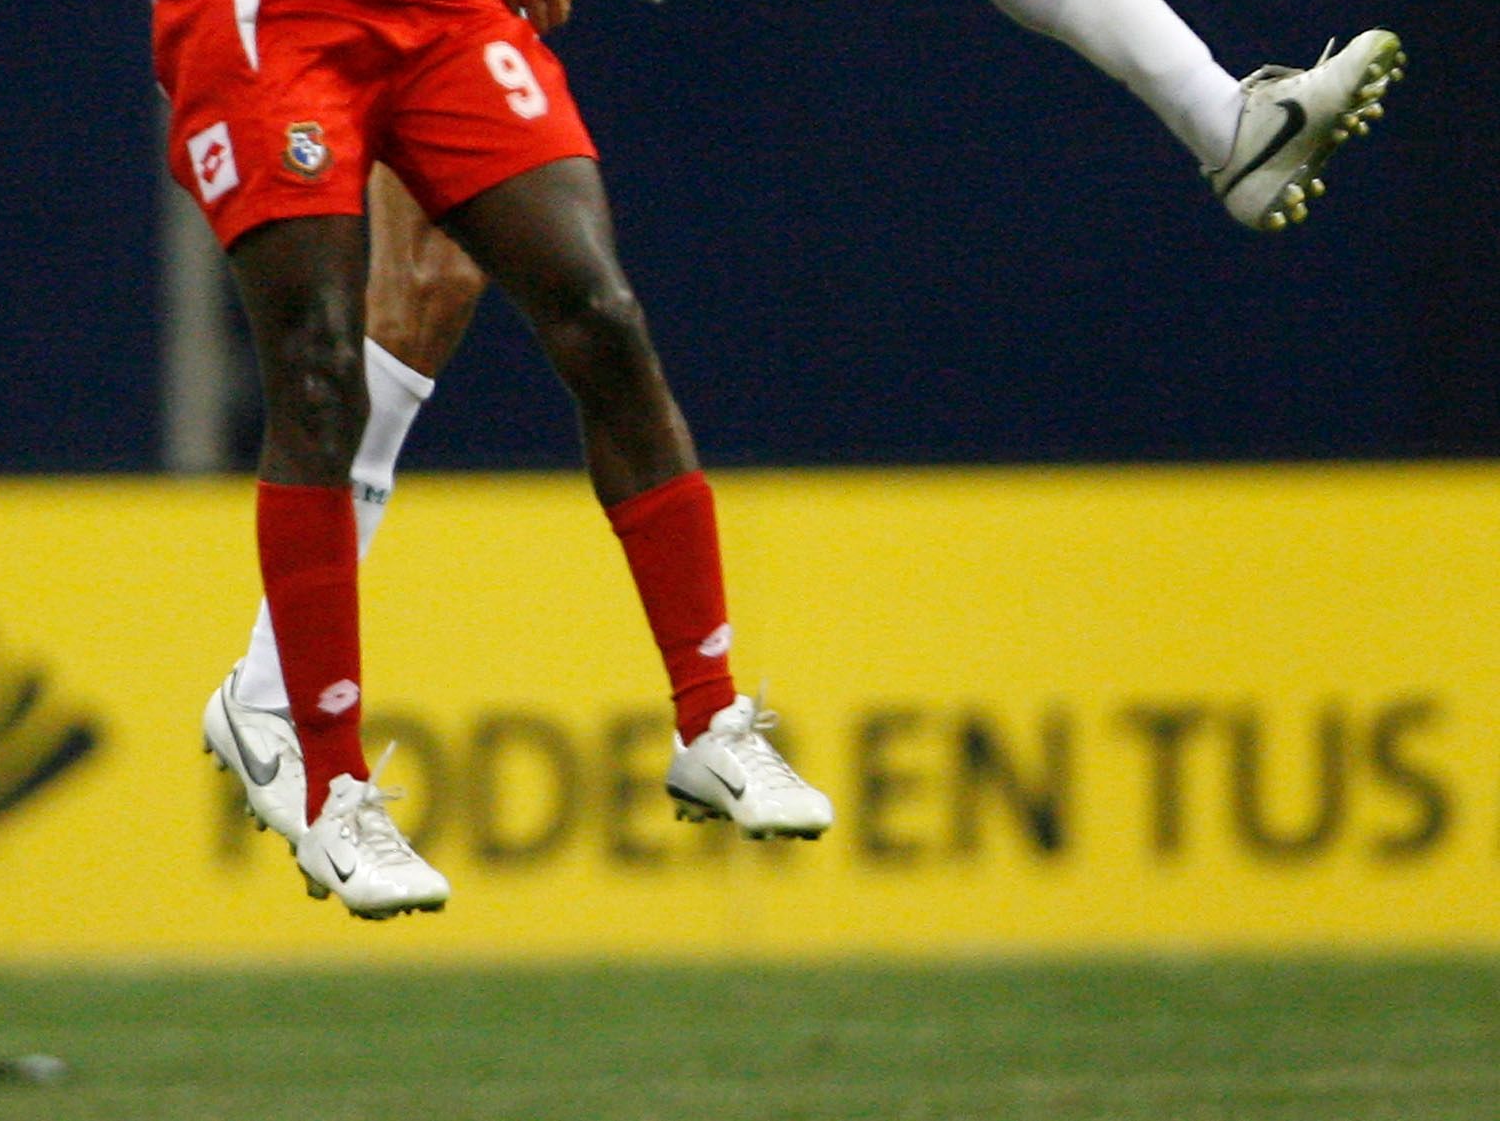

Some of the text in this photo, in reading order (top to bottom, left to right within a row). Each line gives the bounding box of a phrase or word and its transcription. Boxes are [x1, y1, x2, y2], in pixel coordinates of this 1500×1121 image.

[483, 40, 550, 120] 9
[850, 692, 1075, 868] EN
[1112, 692, 1456, 870] TUS
